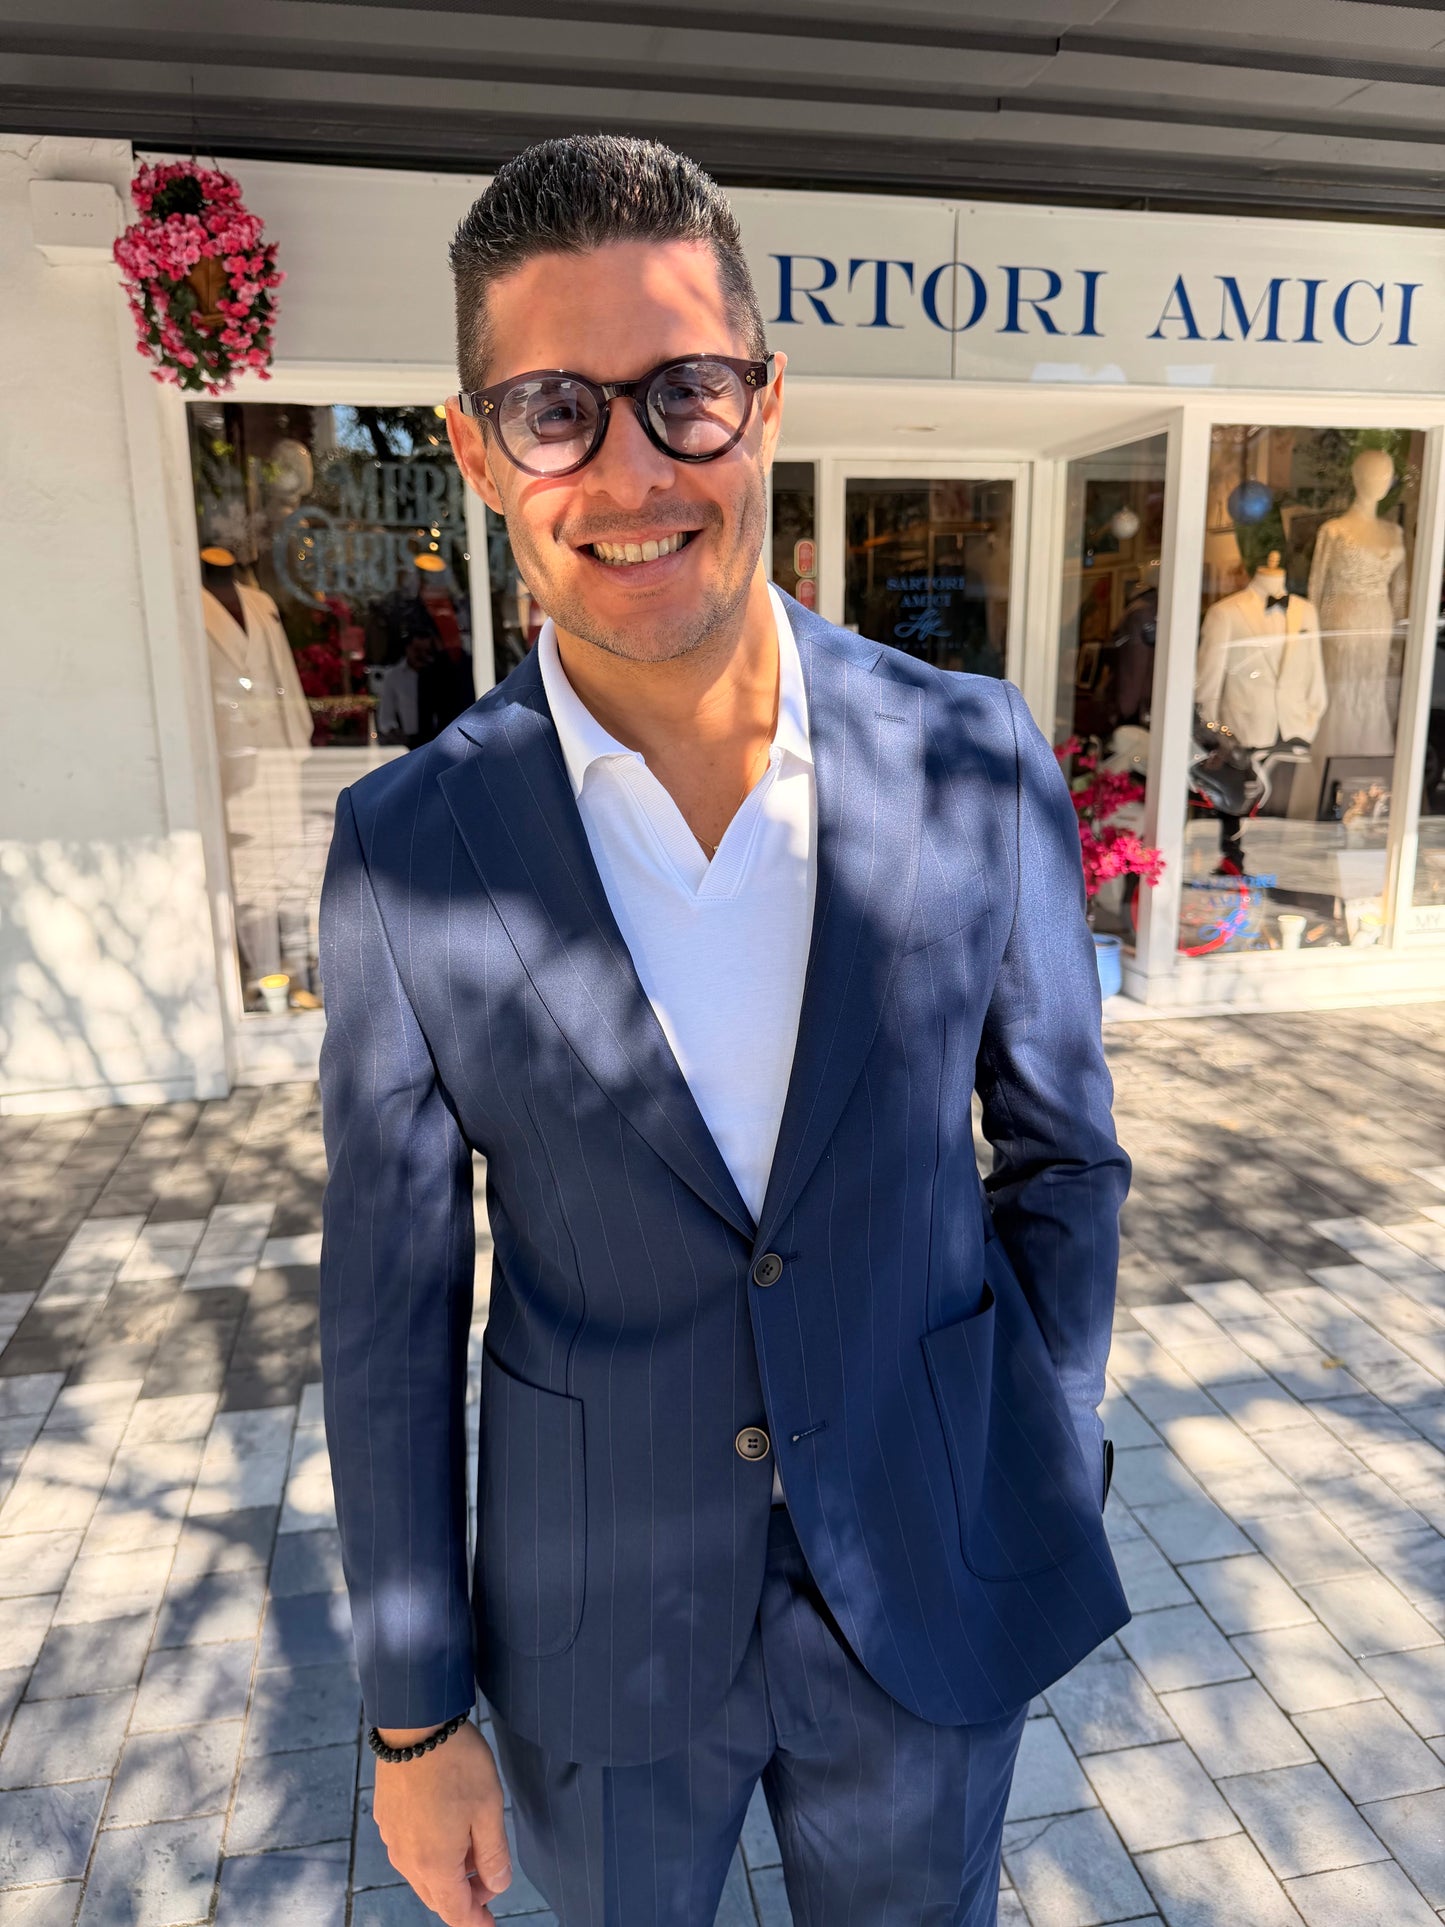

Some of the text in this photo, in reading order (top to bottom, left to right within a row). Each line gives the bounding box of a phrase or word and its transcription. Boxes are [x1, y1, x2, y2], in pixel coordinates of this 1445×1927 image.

[768, 254, 1423, 347] RTORI AMICI
[886, 575, 965, 591] SARTORI
